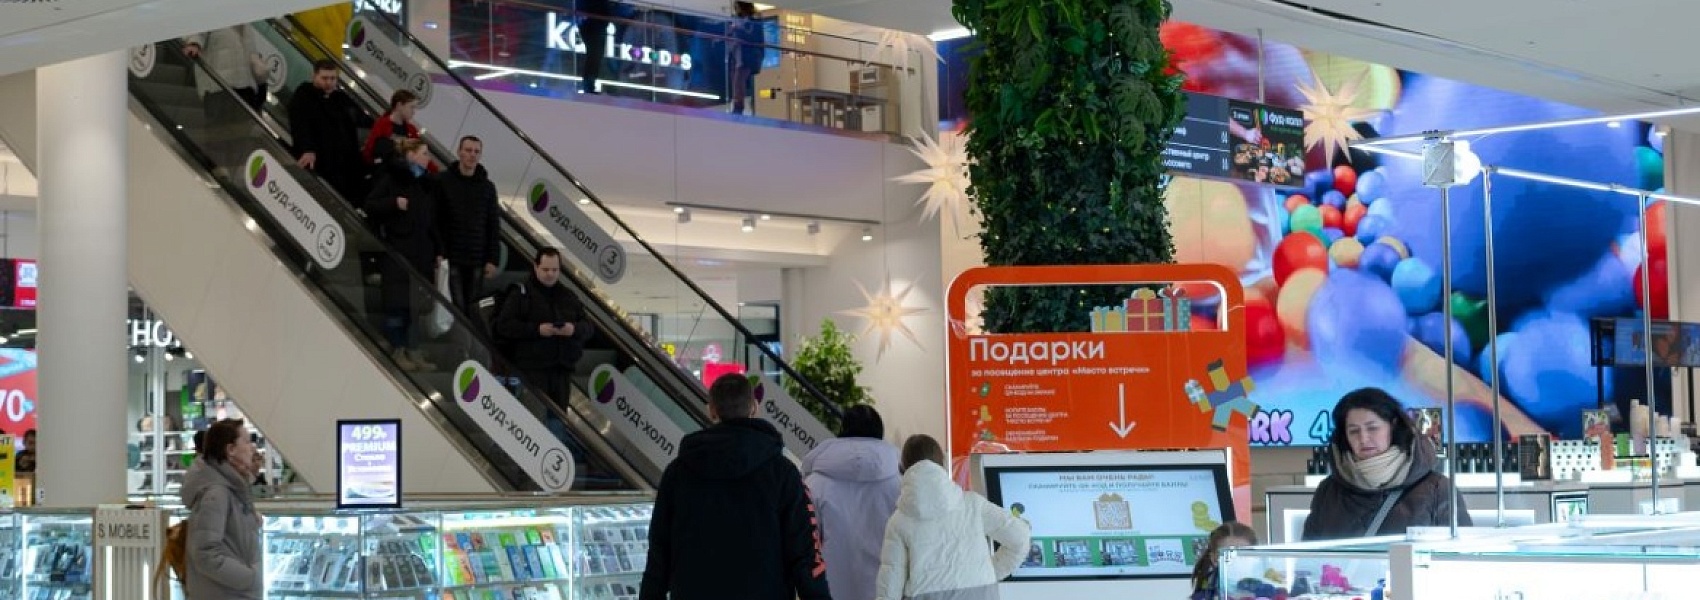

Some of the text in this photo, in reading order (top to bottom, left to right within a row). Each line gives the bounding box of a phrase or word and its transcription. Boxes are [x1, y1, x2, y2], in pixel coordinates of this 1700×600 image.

[415, 79, 425, 91] 3
[326, 230, 336, 246] 3
[607, 251, 617, 265] 3
[969, 338, 1106, 366] Подарки
[552, 455, 564, 471] 3
[98, 523, 150, 540] S MOBILE
